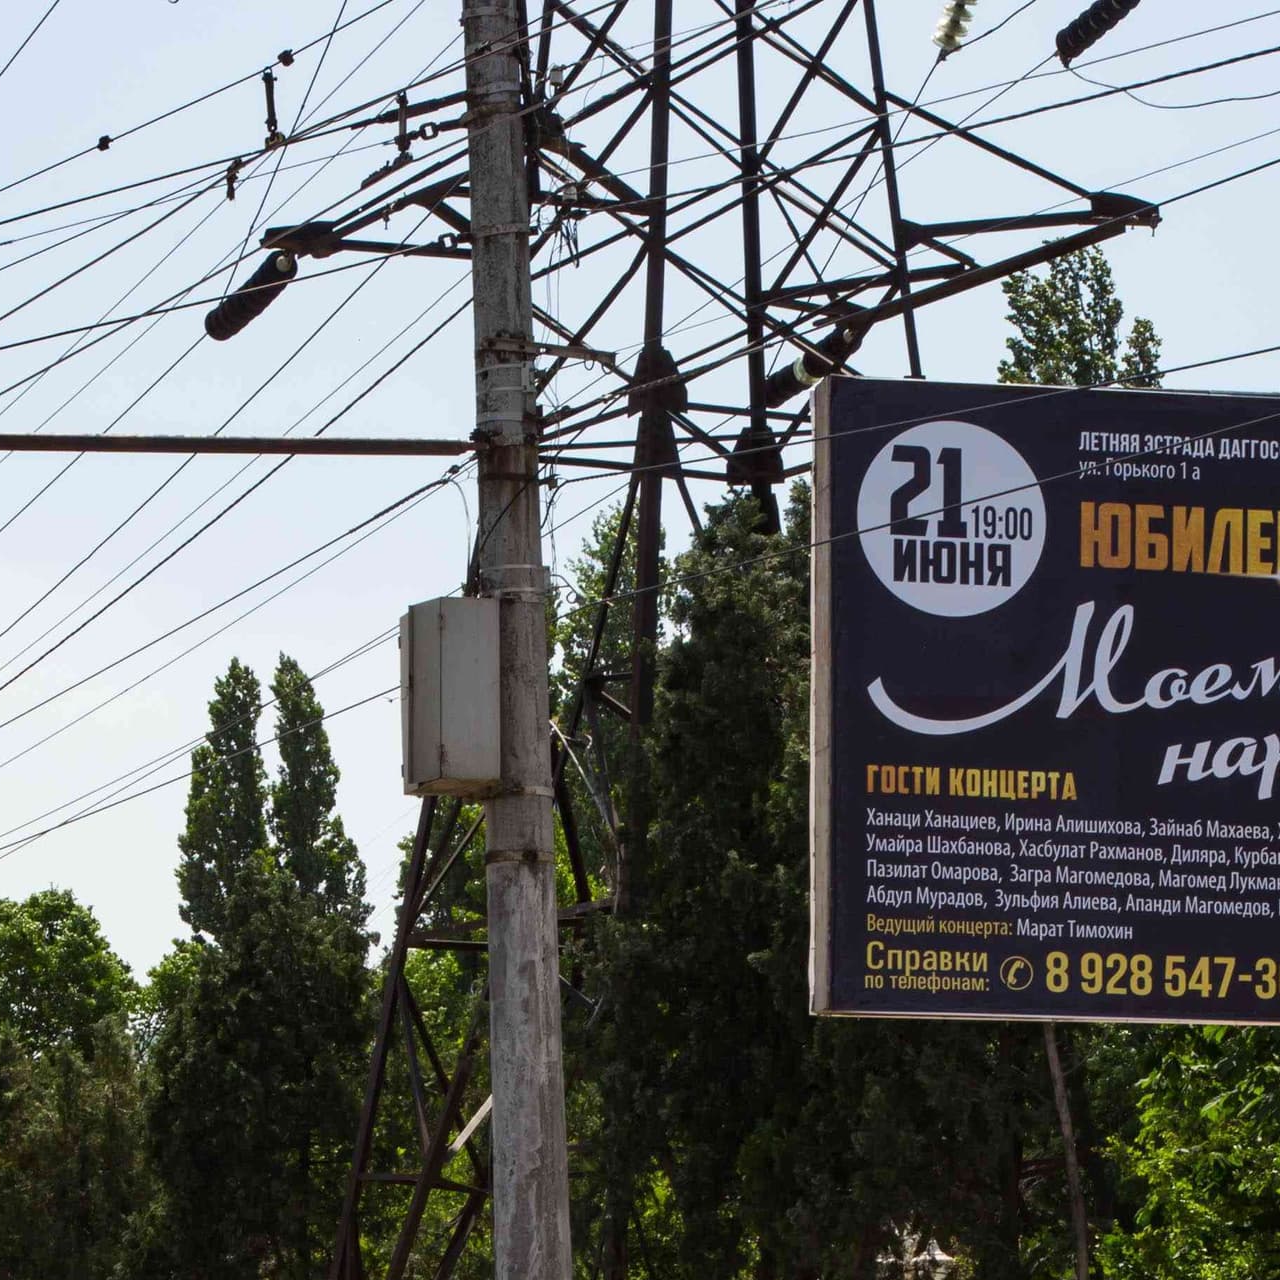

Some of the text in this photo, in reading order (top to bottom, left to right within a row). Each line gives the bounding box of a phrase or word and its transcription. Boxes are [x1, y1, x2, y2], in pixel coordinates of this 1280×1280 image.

[1078, 430, 1141, 454] ЛЕТНЯЯ
[1143, 433, 1215, 459] ЭСТРАДА
[1079, 459, 1102, 480] ул.
[1105, 456, 1176, 481] Горького
[890, 444, 968, 539] 21
[971, 504, 1033, 541] 19:00
[893, 538, 1012, 587] ИЮНЯ
[866, 764, 1077, 801] ГОСТИ КОНЦЕРТА
[866, 807, 921, 830] Ханаци
[924, 809, 1002, 833] Ханациев,
[1005, 812, 1052, 833] Ирина
[1055, 814, 1146, 837] Алишихова,
[1149, 816, 1203, 838] Зайнаб
[1206, 820, 1274, 842] Махаева,
[866, 833, 923, 857] Умайра
[927, 835, 1016, 859] Шахбанова,
[1019, 838, 1087, 862] Хасбулат
[1090, 841, 1167, 864] Рахманов,
[1171, 844, 1230, 867] Диляра,
[866, 859, 928, 879] Пазилат
[931, 861, 1003, 884] Омарова,
[1009, 864, 1052, 887] Загра
[1055, 865, 1155, 888] Магомедова,
[1159, 869, 1227, 892] Магомед
[866, 885, 913, 908] Абдул
[916, 886, 988, 909] Мурадов,
[994, 888, 1059, 912] Зульфия
[1062, 891, 1122, 913] Алиева,
[1125, 893, 1182, 915] Апанди
[1184, 896, 1275, 918] Магомедов,
[866, 913, 1134, 941] Ведущий концерта: Марат Тимохин
[866, 940, 989, 976] Справки
[1045, 951, 1070, 994] 8
[1080, 952, 1154, 997] 928
[864, 972, 990, 994] по телефонам:
